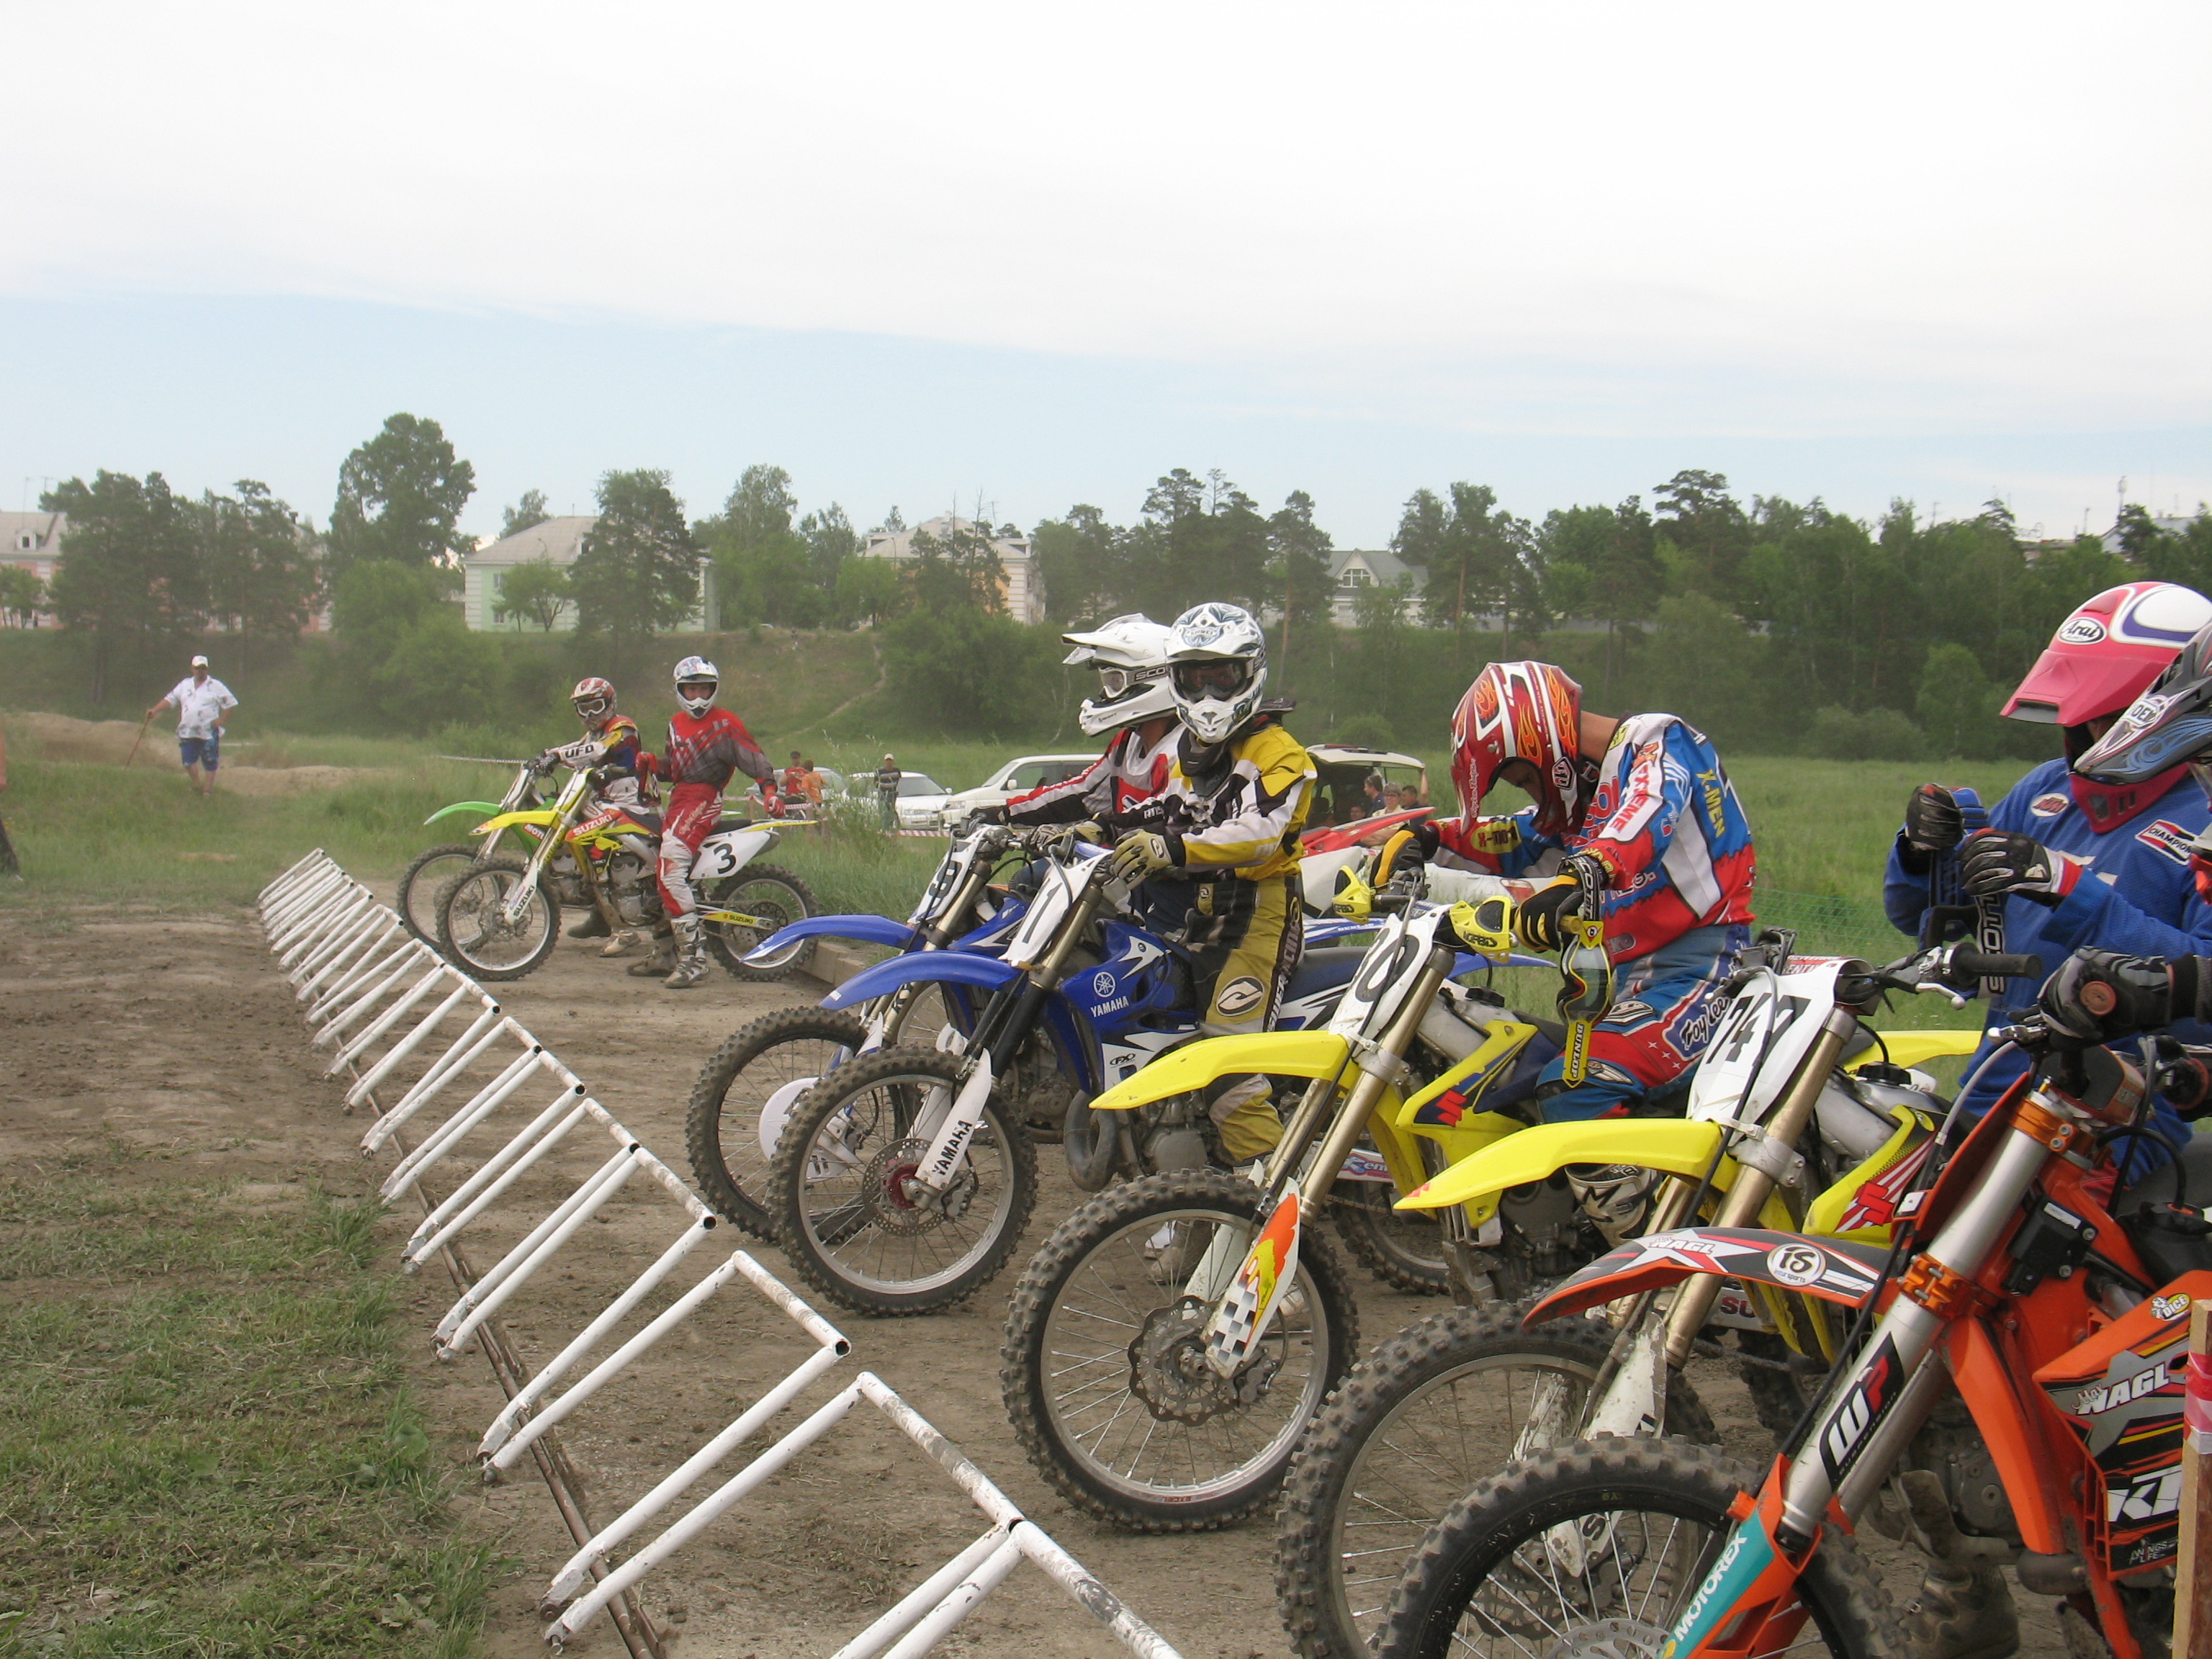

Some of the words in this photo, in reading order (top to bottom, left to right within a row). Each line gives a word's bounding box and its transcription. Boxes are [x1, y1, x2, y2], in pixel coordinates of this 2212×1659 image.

[2060, 620, 2100, 638] Arai
[1135, 666, 1166, 681] SCO
[1696, 769, 1725, 838] X-MEN
[572, 814, 612, 837] SUZUKI
[2147, 827, 2193, 855] CHAMPION
[714, 842, 737, 874] 3
[513, 884, 536, 917] SUZUKI
[728, 914, 754, 925] SUZUKI
[1090, 995, 1130, 1018] YAMAHA
[1705, 992, 1812, 1065] 747
[1569, 1022, 1584, 1080] DUNLOP
[932, 1120, 974, 1176] YAMAHA
[1649, 1238, 1716, 1255] NAGL
[2162, 1295, 2189, 1318] DICE
[2072, 1382, 2105, 1410] Max
[2076, 1361, 2171, 1416] NAGL
[2107, 1464, 2182, 1523] KT
[1673, 1530, 1748, 1642] MOTOREX
